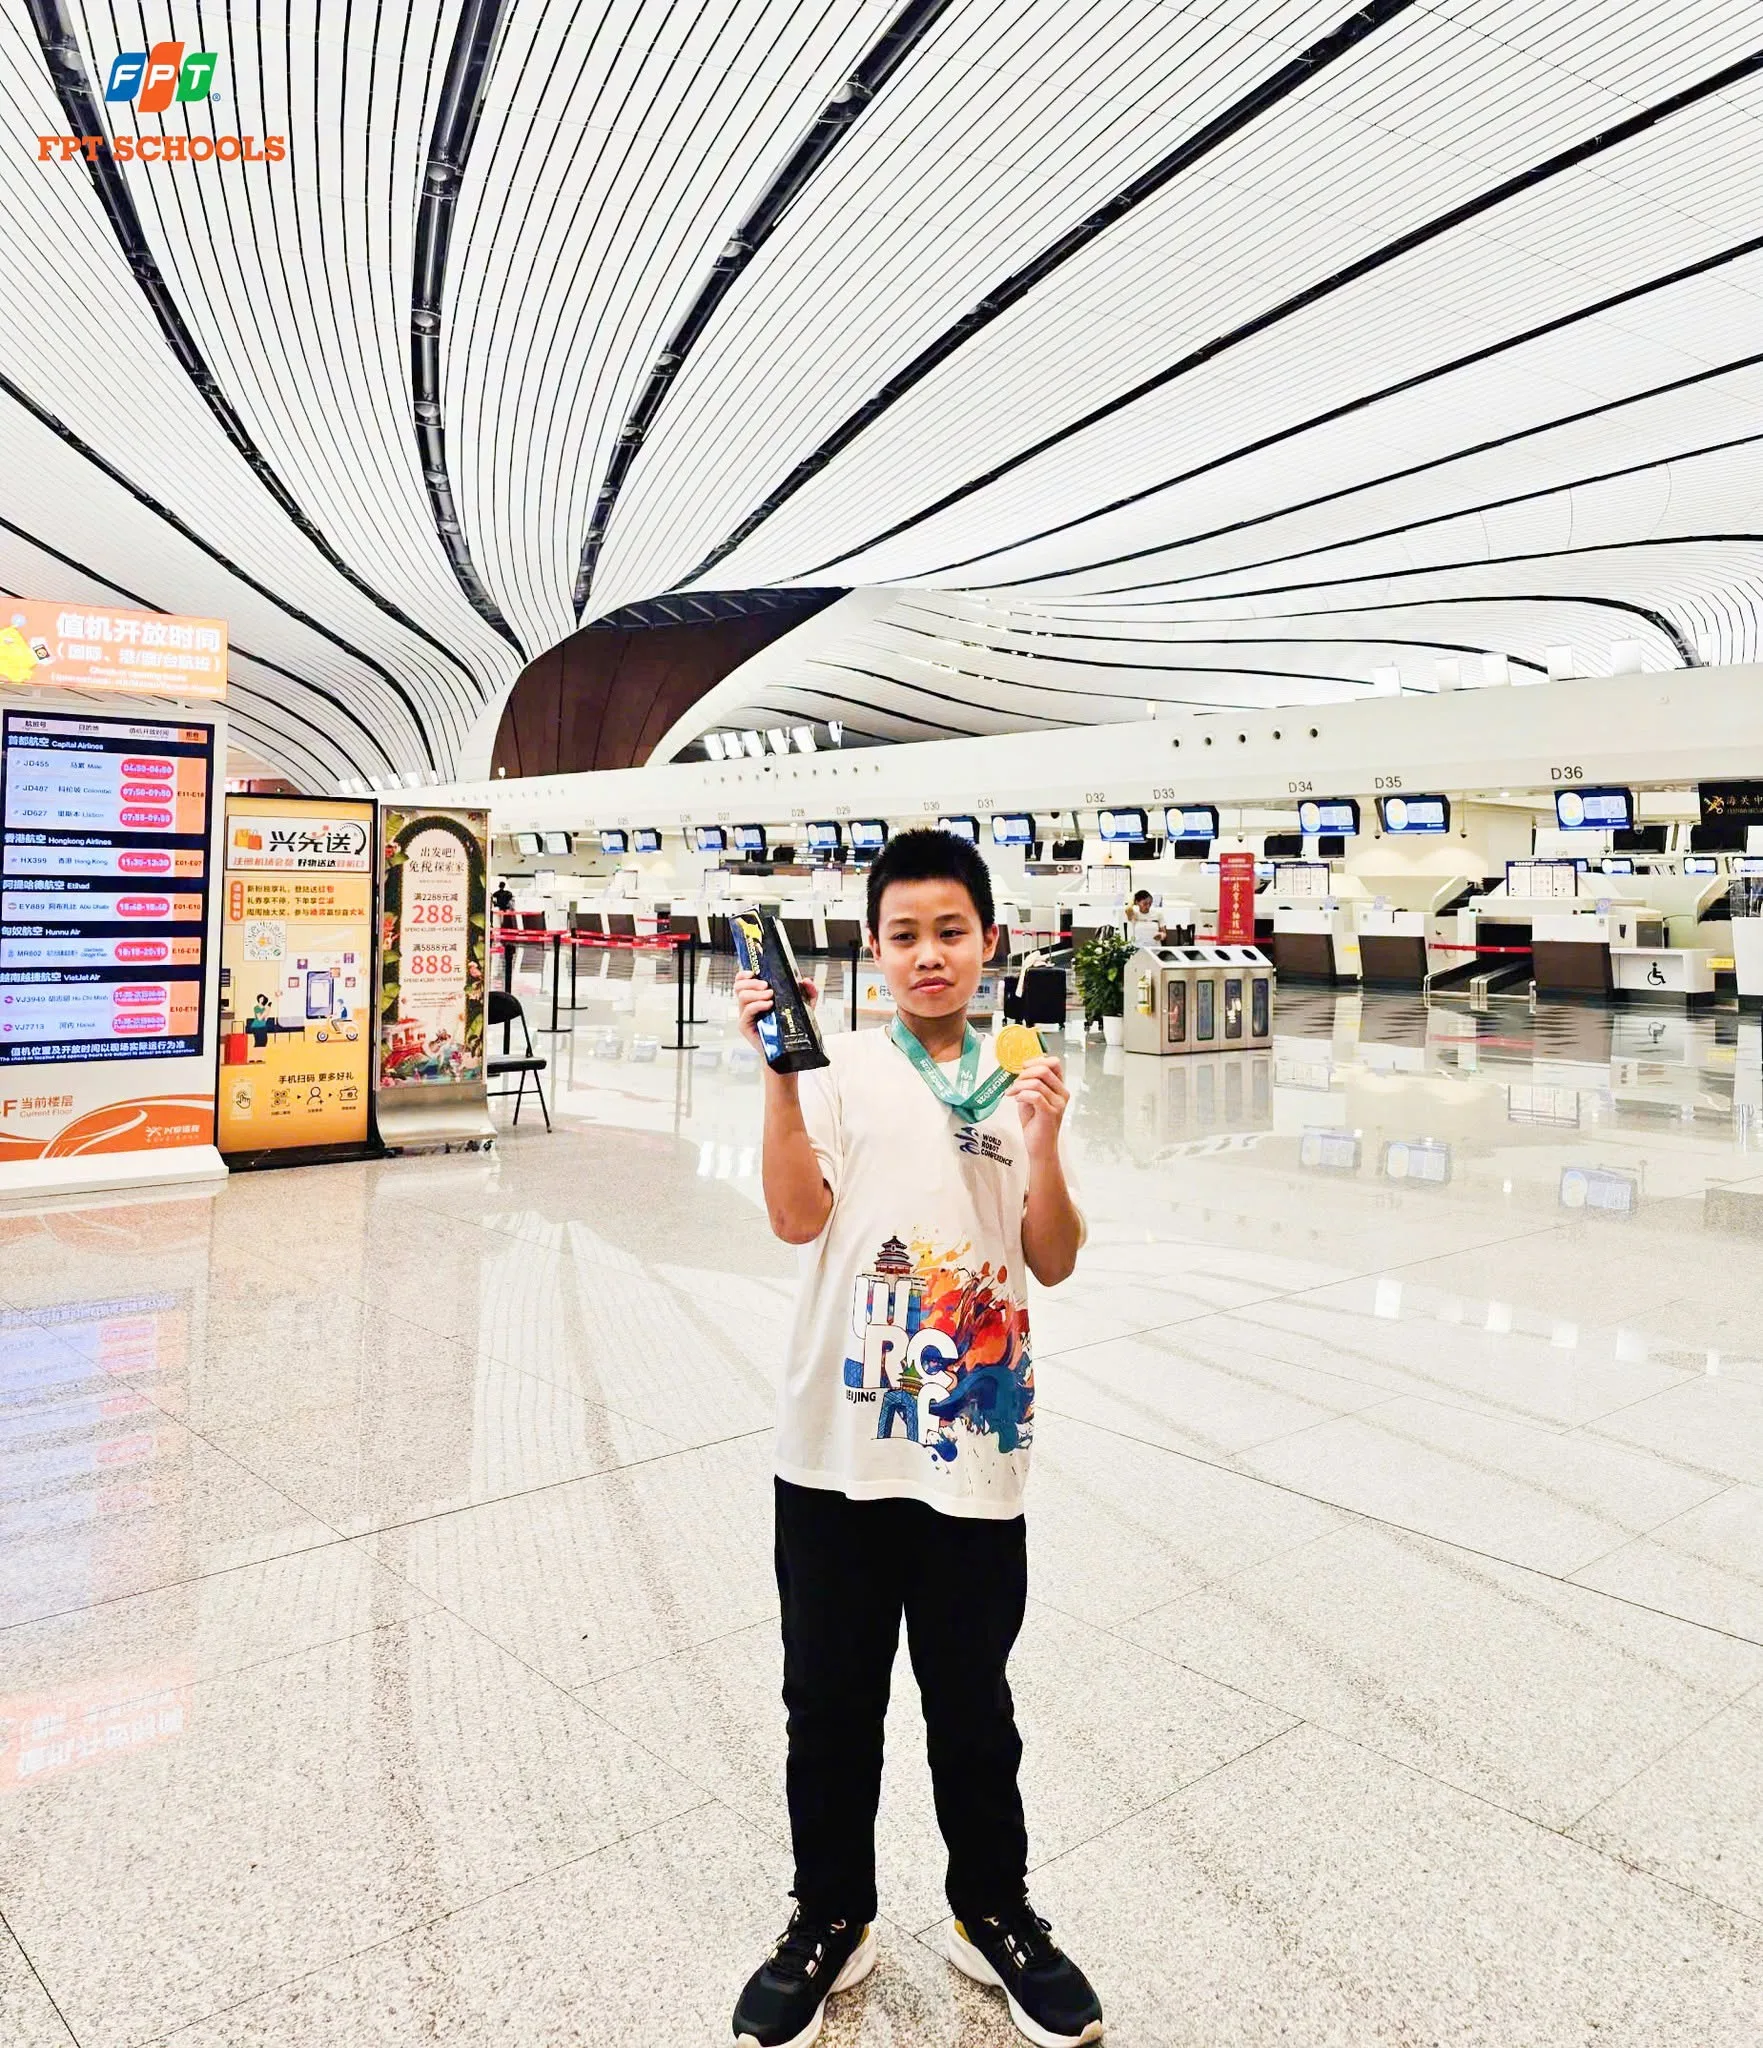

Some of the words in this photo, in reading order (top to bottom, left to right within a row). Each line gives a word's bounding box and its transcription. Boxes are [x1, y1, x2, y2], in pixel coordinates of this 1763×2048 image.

[57, 613, 220, 652] 值机开放时间
[8, 735, 49, 747] 首都航空
[52, 741, 76, 749] Capital
[78, 742, 104, 750] Airlines
[1551, 766, 1583, 780] D36
[1288, 781, 1313, 793] D34
[1374, 776, 1402, 789] D35
[1086, 792, 1105, 803] D32
[1153, 788, 1175, 799] D33
[923, 801, 940, 811] D30
[978, 798, 995, 809] D31
[791, 809, 805, 817] D28
[48, 837, 84, 845] Hongkong
[45, 928, 69, 936] Hunnu
[279, 1074, 315, 1084] 手机扫码
[22, 1095, 73, 1109] 当前楼层
[982, 1134, 1002, 1146] WORLD
[981, 1141, 999, 1153] ROBOT
[981, 1148, 1014, 1167] CONFERENCE
